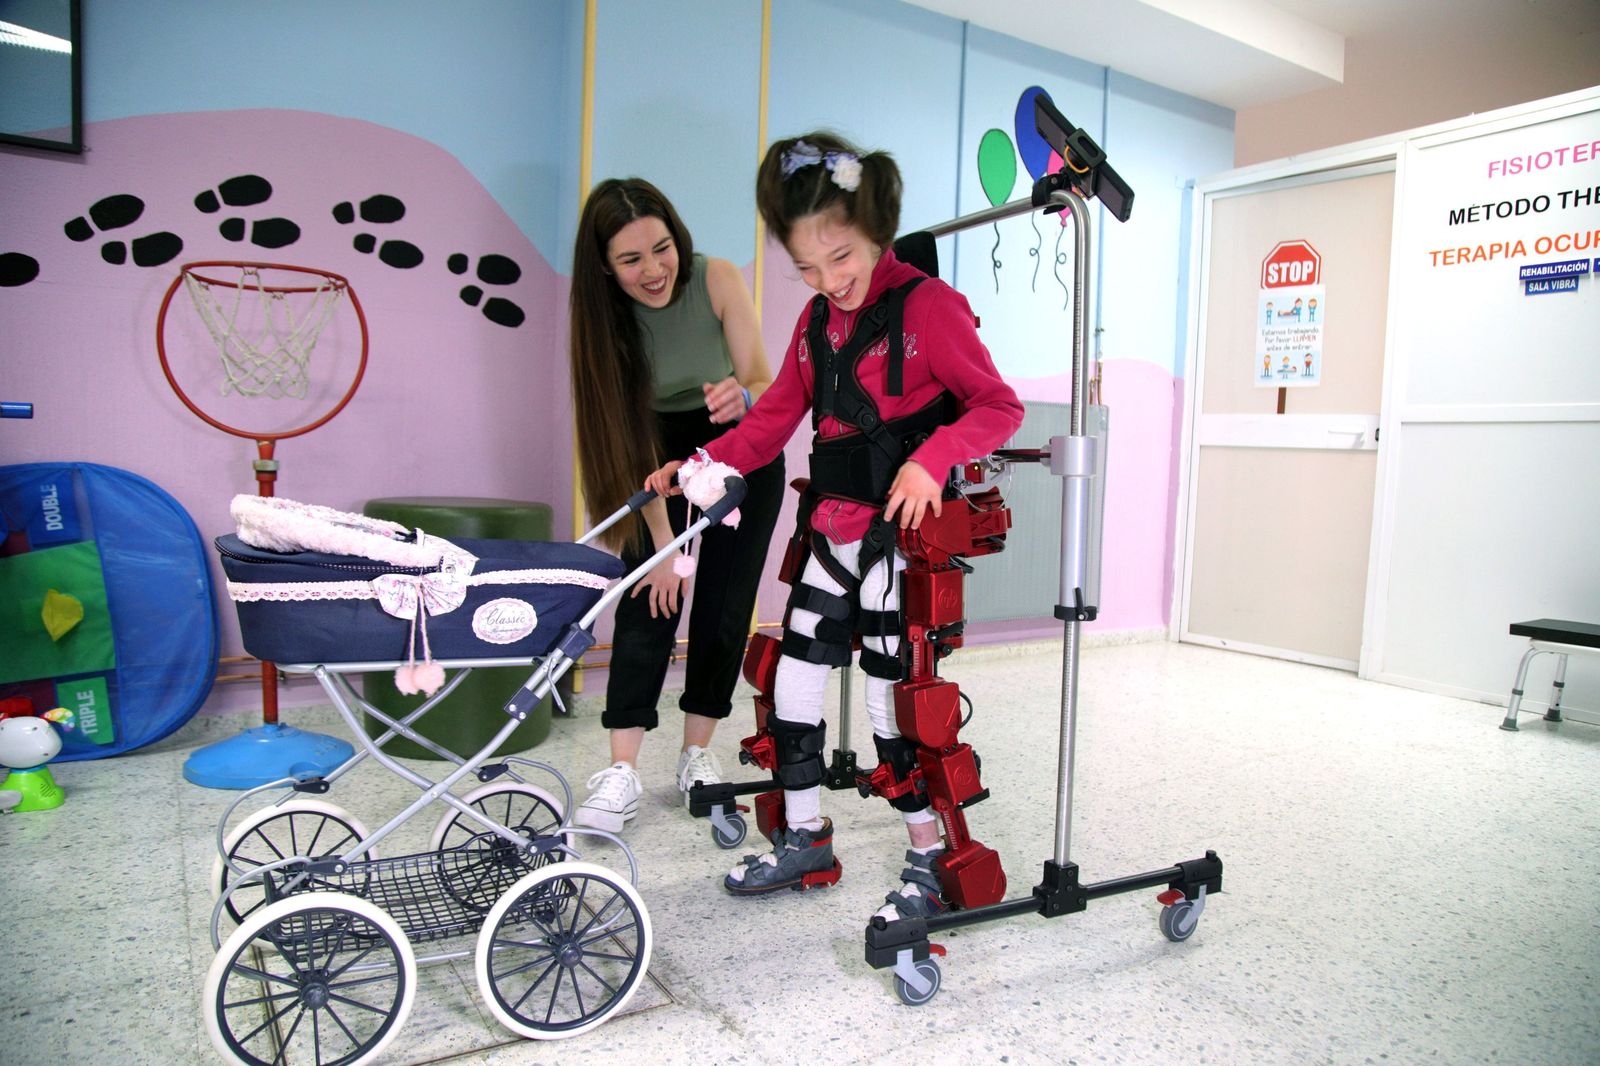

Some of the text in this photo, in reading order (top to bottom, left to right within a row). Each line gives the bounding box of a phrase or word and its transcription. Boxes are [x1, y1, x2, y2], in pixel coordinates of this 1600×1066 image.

[1449, 195, 1550, 226] MÉTODO
[1429, 240, 1527, 267] TERAPIA
[1268, 261, 1314, 284] STOP
[1521, 262, 1588, 277] REHABILITACIÓN
[1528, 278, 1576, 292] SALA VIBRA
[39, 484, 64, 532] DOUBLE
[486, 607, 526, 626] Classic
[76, 689, 99, 735] TRIPLE
